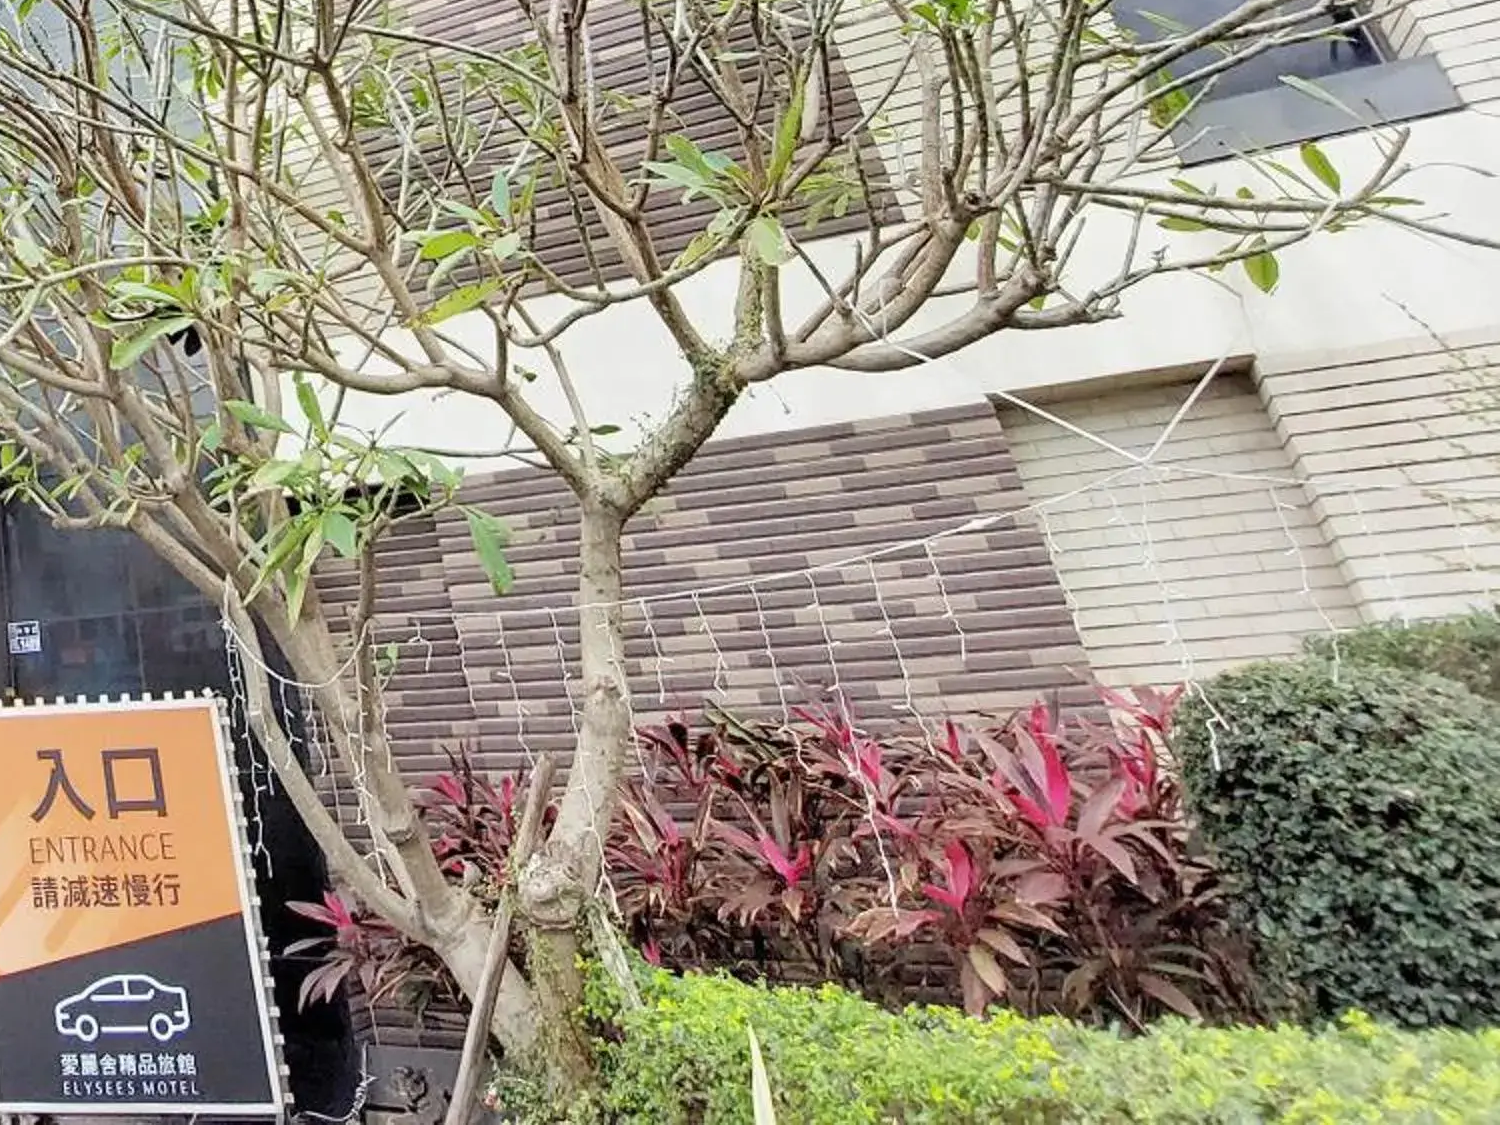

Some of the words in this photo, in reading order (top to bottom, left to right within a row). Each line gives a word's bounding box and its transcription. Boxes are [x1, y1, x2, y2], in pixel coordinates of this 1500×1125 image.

[30, 747, 168, 824] 入口
[28, 832, 177, 865] ENTRANCE
[31, 873, 182, 909] 請減速慢行
[60, 1052, 197, 1076] 愛麗舍精品旅館
[62, 1080, 136, 1096] ELYSEES
[142, 1079, 200, 1096] MOTEL
